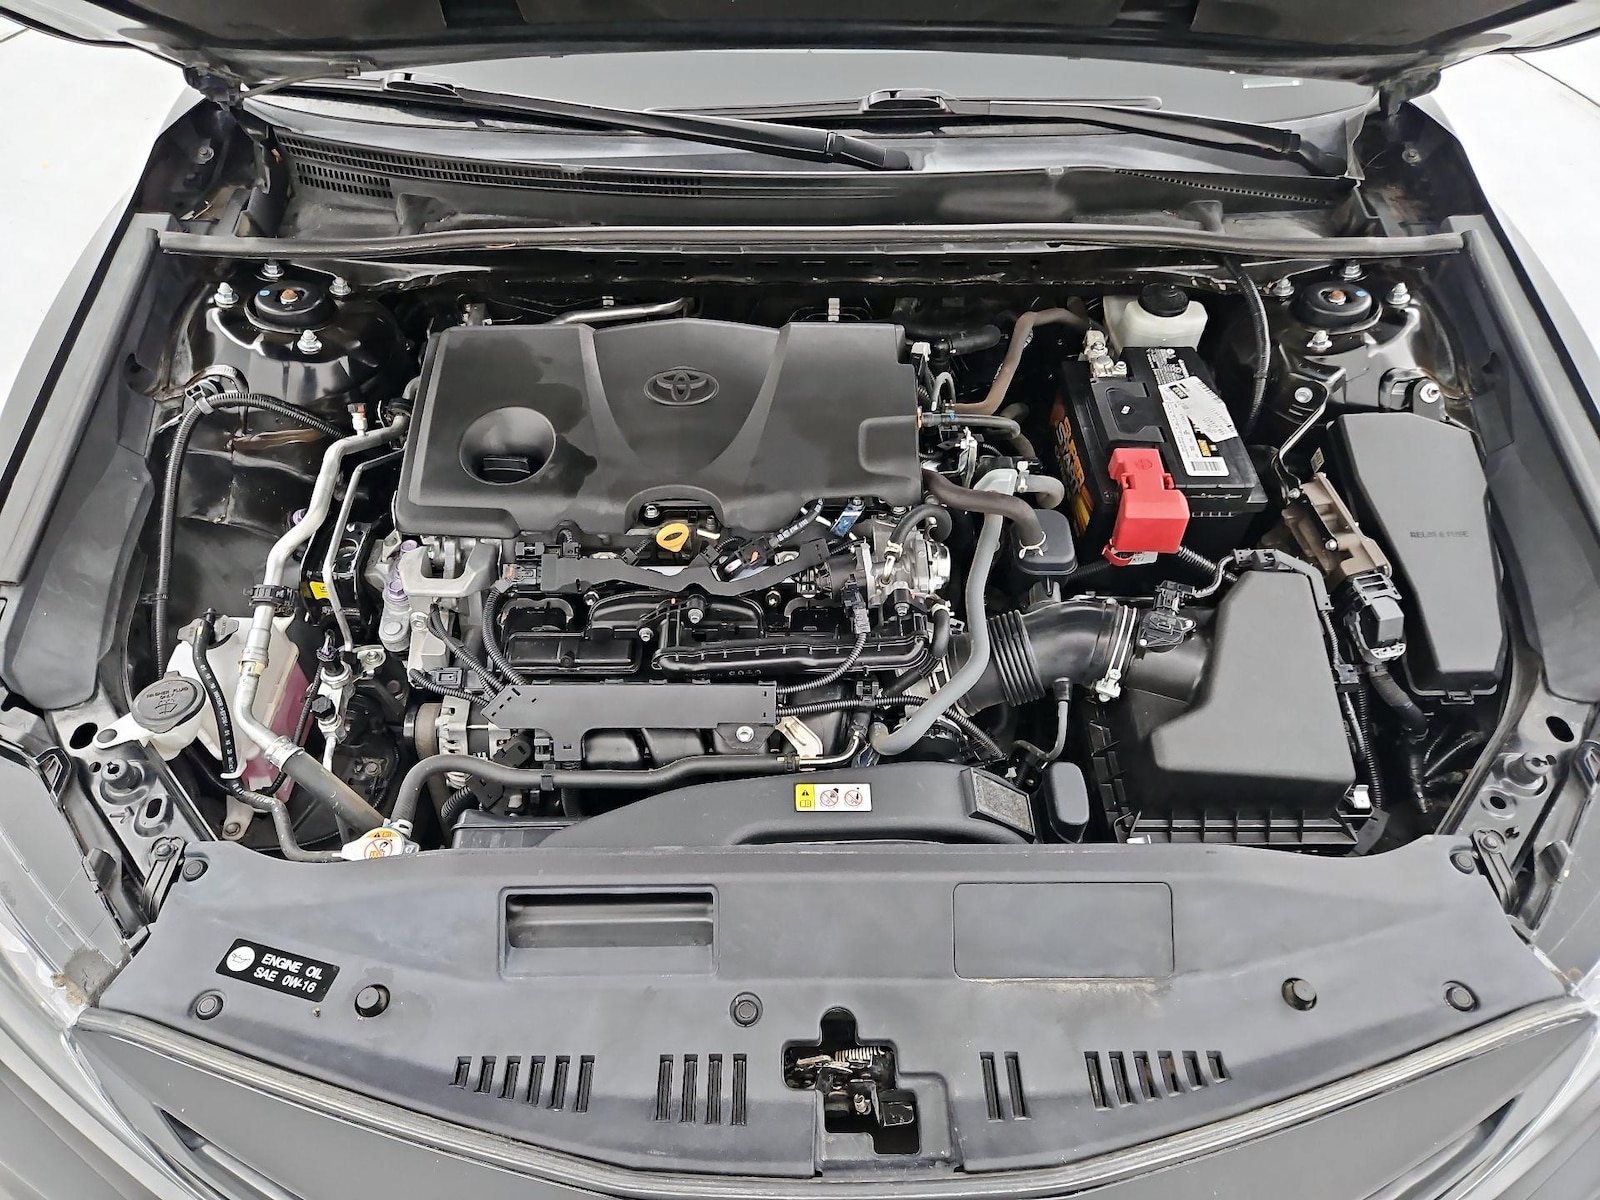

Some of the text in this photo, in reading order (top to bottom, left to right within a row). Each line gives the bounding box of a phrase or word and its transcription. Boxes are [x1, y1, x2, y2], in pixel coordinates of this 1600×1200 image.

[253, 966, 317, 993] SAE 0W-16
[261, 953, 323, 980] ENGINE OIL
